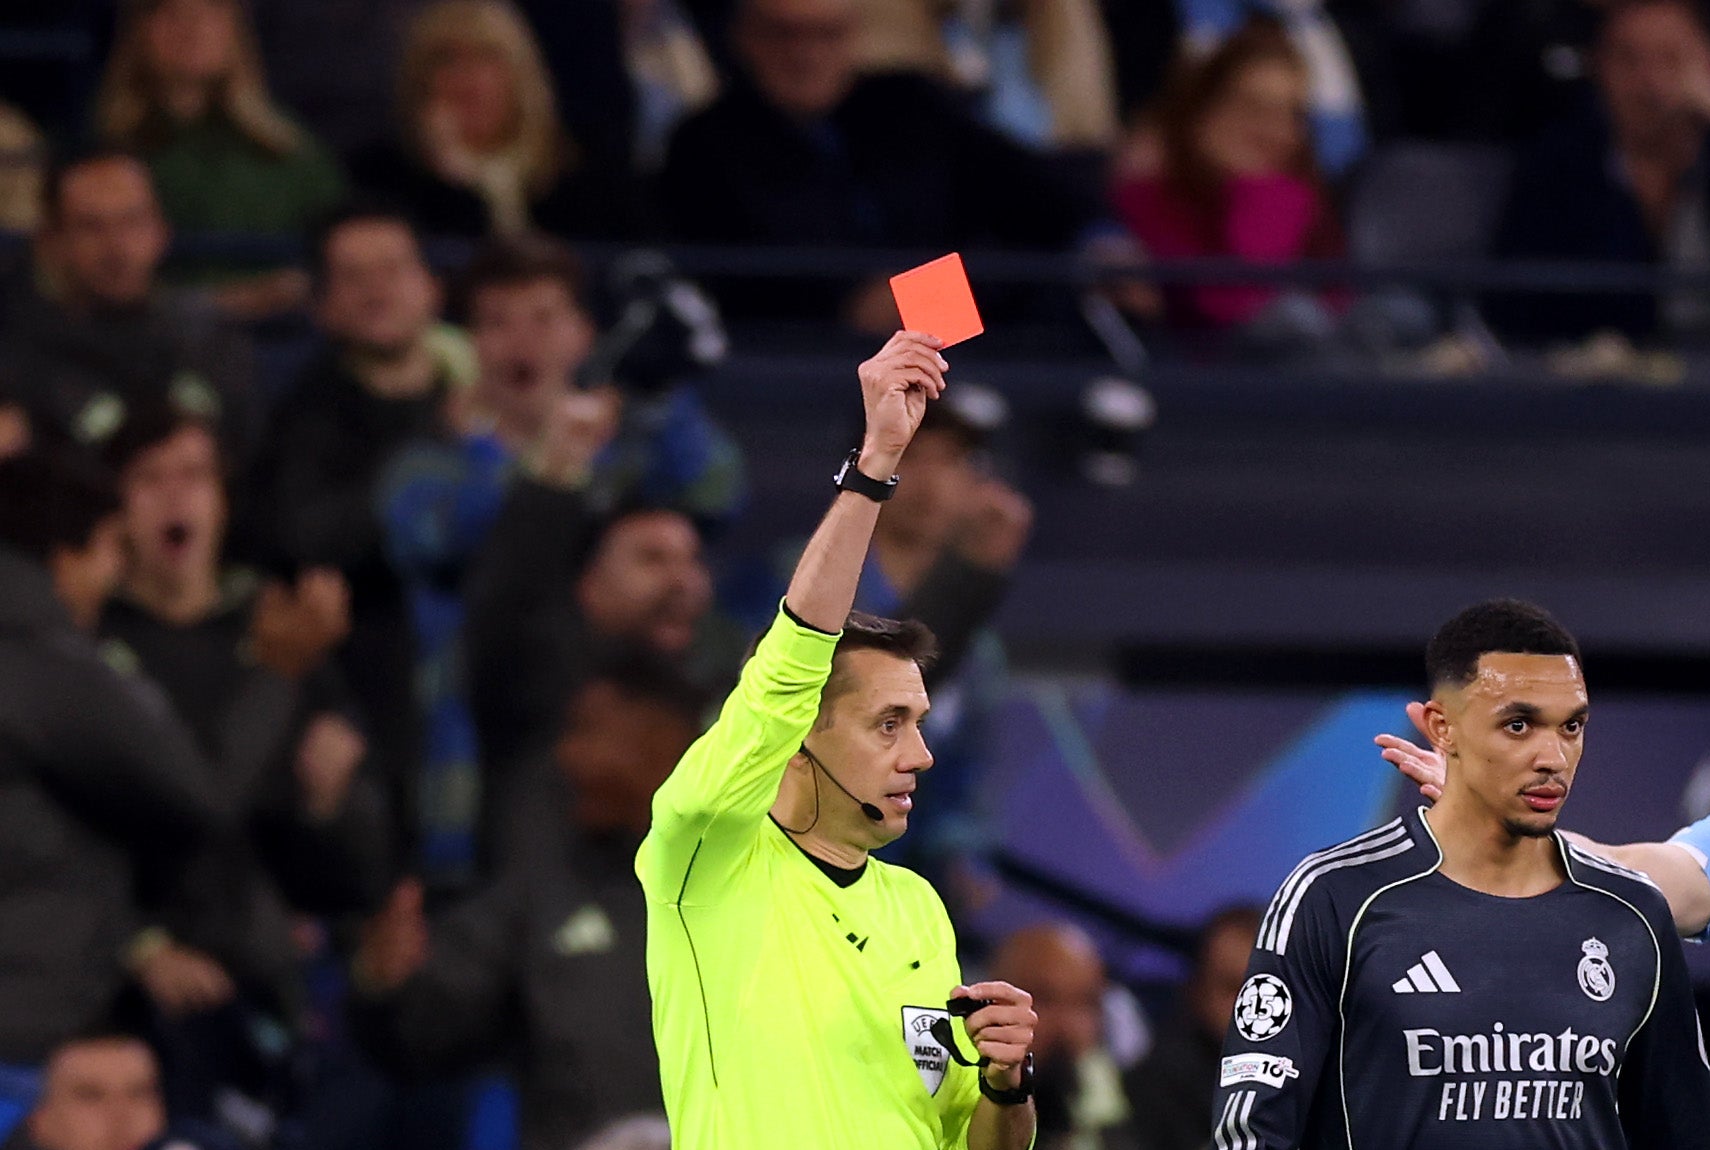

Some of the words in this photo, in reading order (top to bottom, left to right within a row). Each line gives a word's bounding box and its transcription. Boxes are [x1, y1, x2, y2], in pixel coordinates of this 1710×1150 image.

[914, 1046, 942, 1057] MATCH
[1402, 1021, 1617, 1077] Emirates
[1438, 1080, 1487, 1121] FLY
[1494, 1080, 1584, 1120] BETTER
